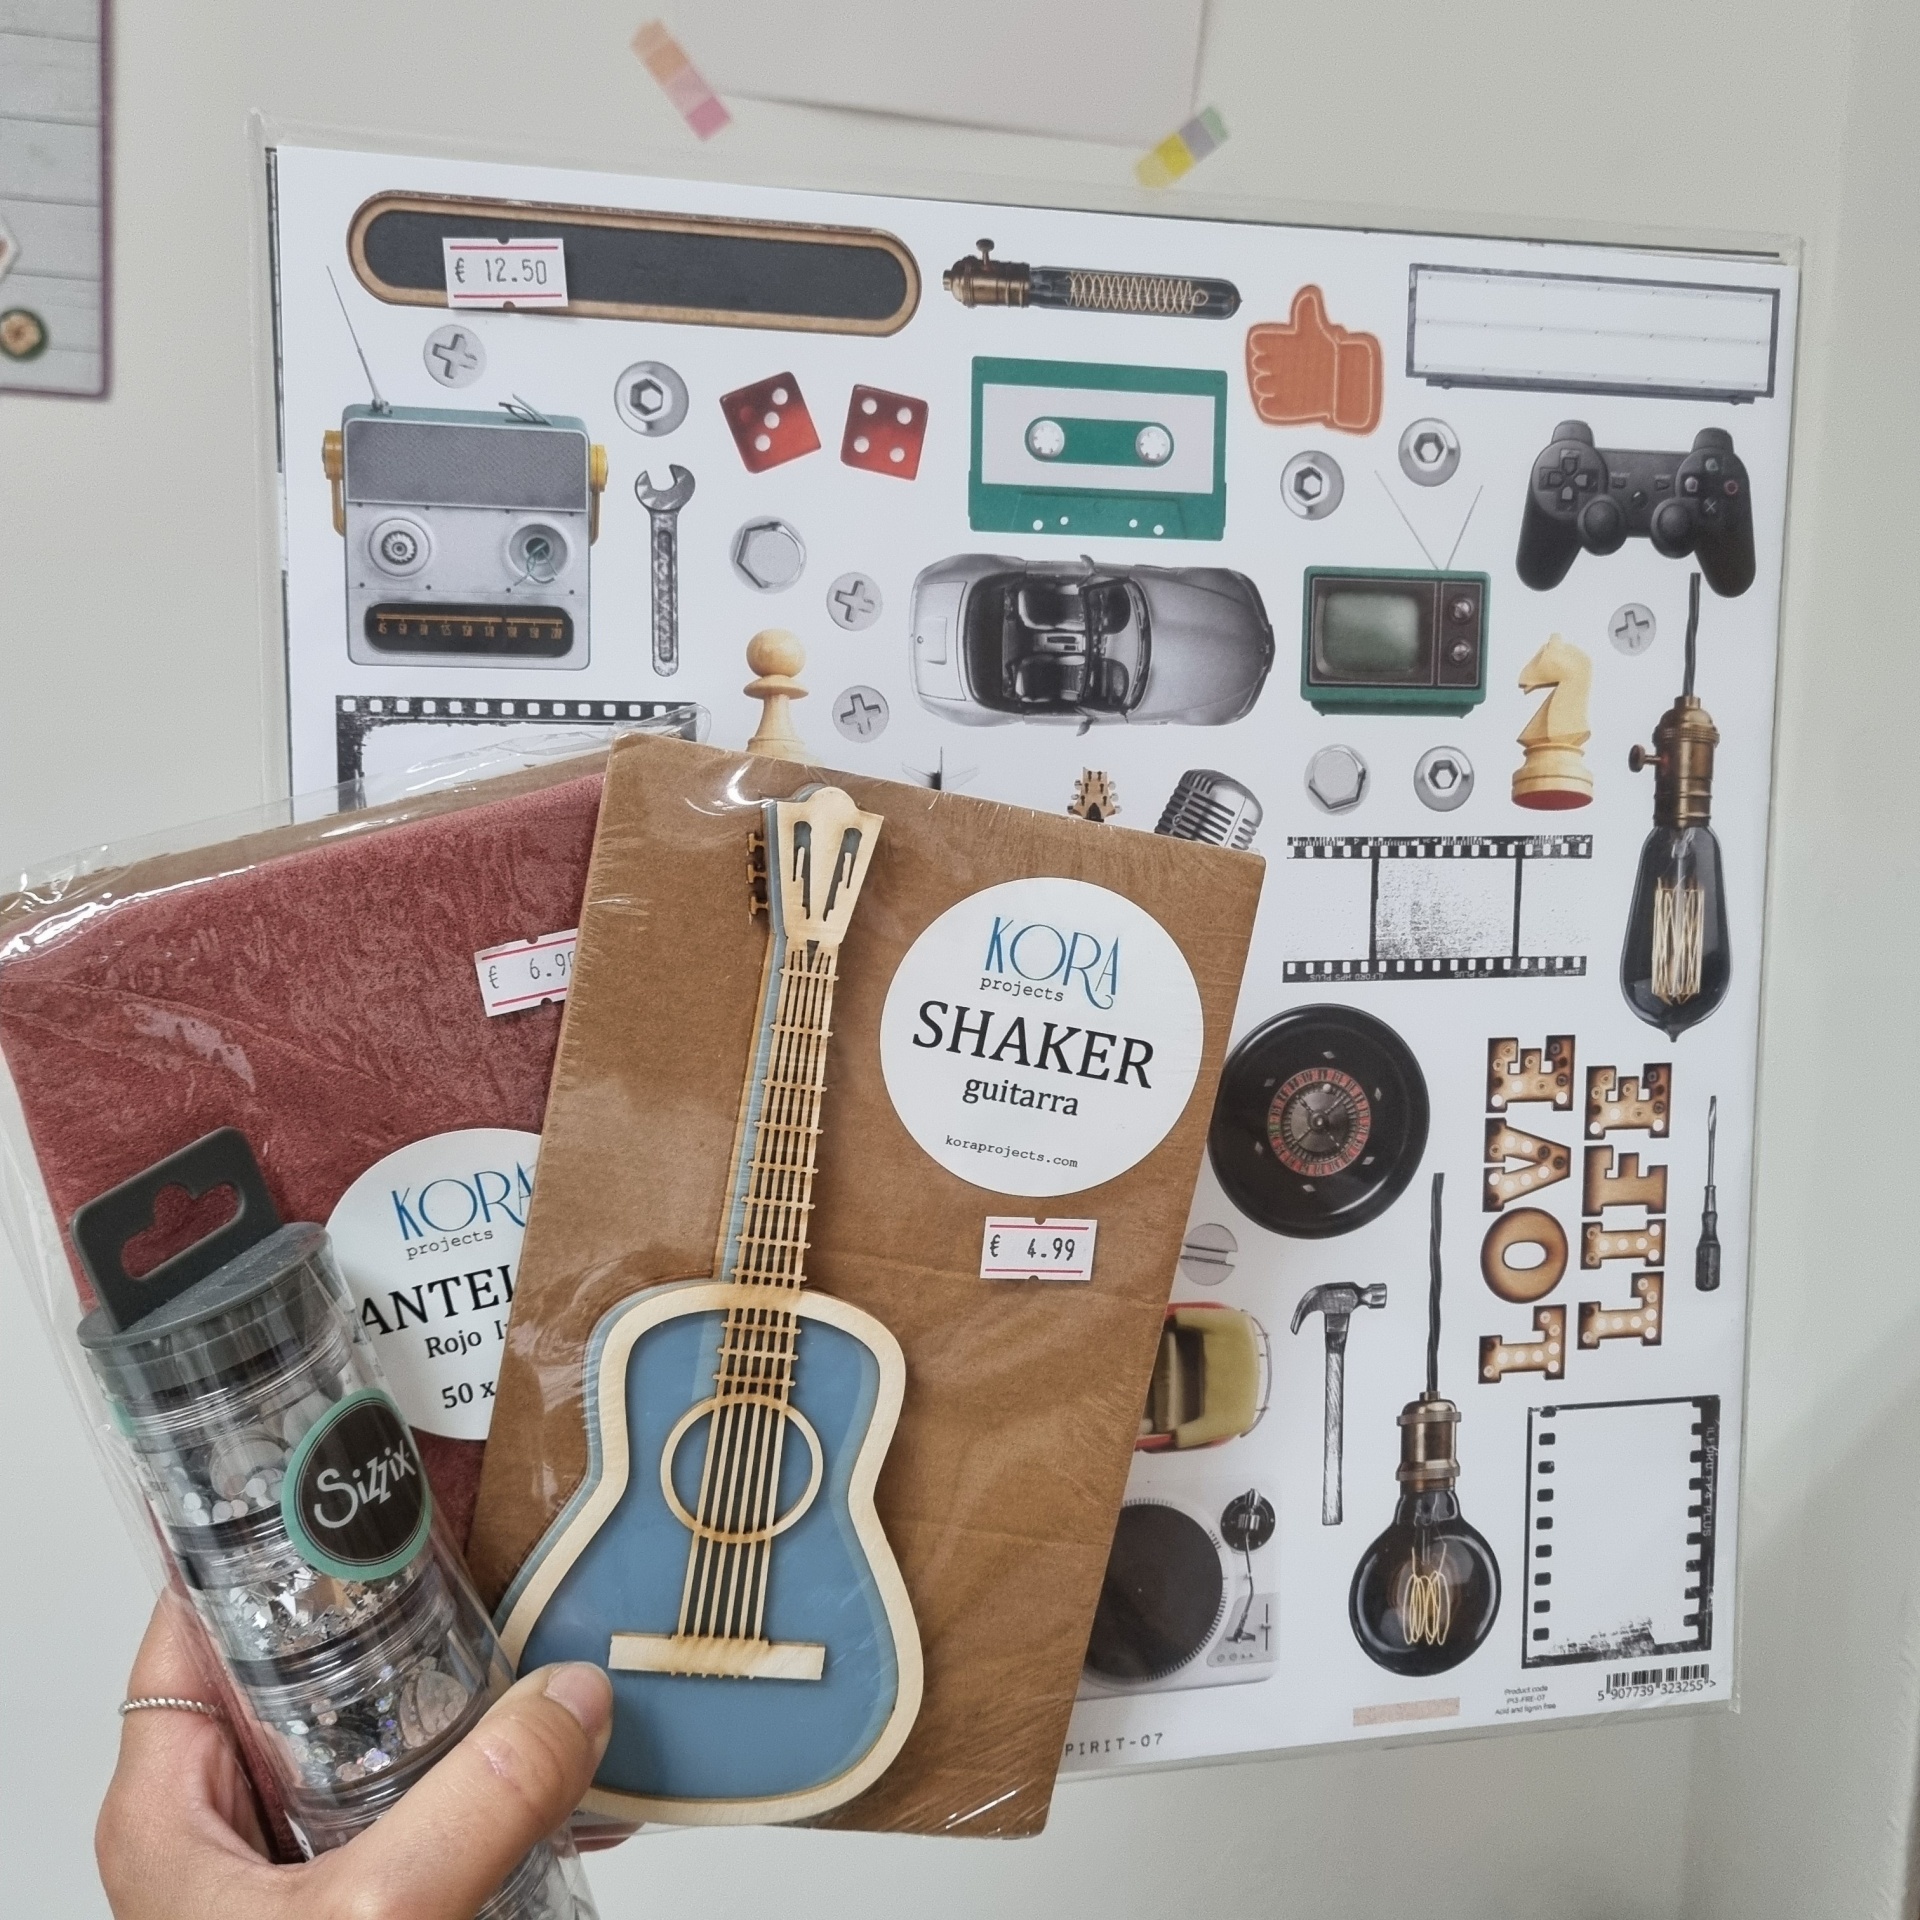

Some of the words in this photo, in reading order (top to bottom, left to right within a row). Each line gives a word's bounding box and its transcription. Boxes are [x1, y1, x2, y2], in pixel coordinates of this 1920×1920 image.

[454, 257, 466, 284] €
[485, 257, 548, 286] 12.50
[488, 964, 500, 990] €
[985, 916, 1120, 1010] KORA
[979, 976, 1065, 1002] projects
[912, 1000, 1154, 1089] SHAKER
[962, 1078, 1080, 1117] guitarra
[945, 1134, 1079, 1168] koraprojects.com
[1478, 1034, 1576, 1384] LOVE
[1577, 1062, 1673, 1350] LIFE
[406, 1228, 494, 1261] projects
[989, 1233, 1001, 1258] €
[1026, 1237, 1076, 1262] 4.99
[424, 1329, 482, 1359] Rojo
[441, 1381, 474, 1410] 50
[481, 1380, 496, 1400] x
[313, 1438, 417, 1530] Sizzix
[1597, 1690, 1605, 1701] 5
[1611, 1683, 1655, 1700] 907739
[1661, 1678, 1704, 1695] 323255
